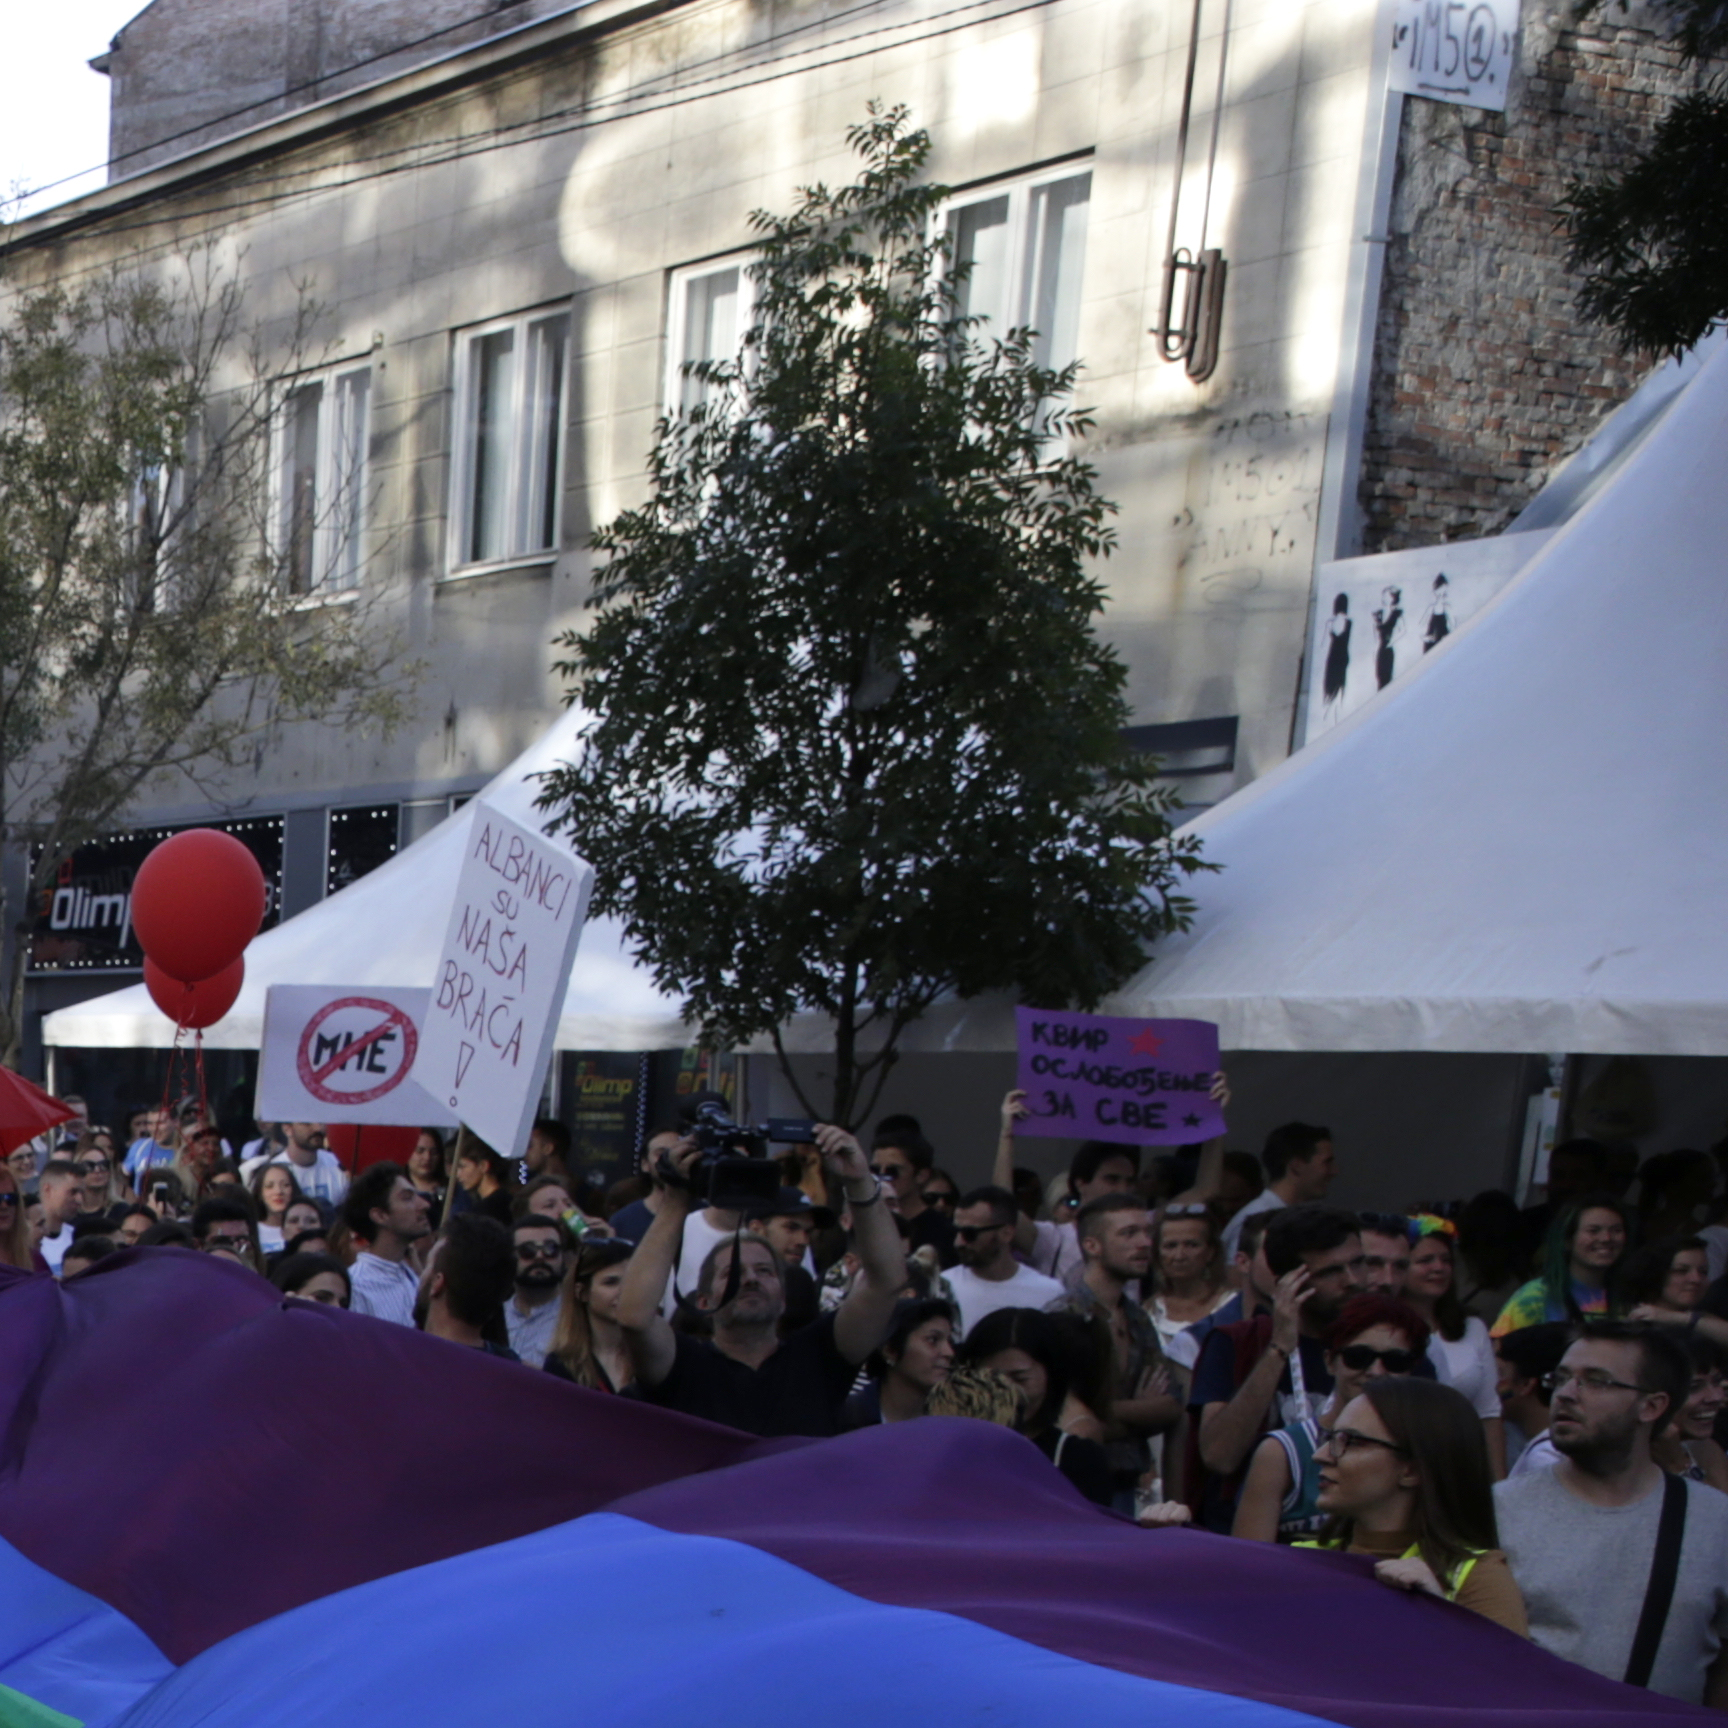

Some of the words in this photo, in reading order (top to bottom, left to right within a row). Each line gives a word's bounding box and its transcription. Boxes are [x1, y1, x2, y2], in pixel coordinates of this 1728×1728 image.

[474, 822, 572, 921] ALBANCI
[492, 890, 520, 920] SU
[457, 905, 528, 993] NAŠA
[1031, 1021, 1109, 1052] КВИР
[1034, 1090, 1076, 1119] ЗА
[1096, 1098, 1168, 1129] СВЕ
